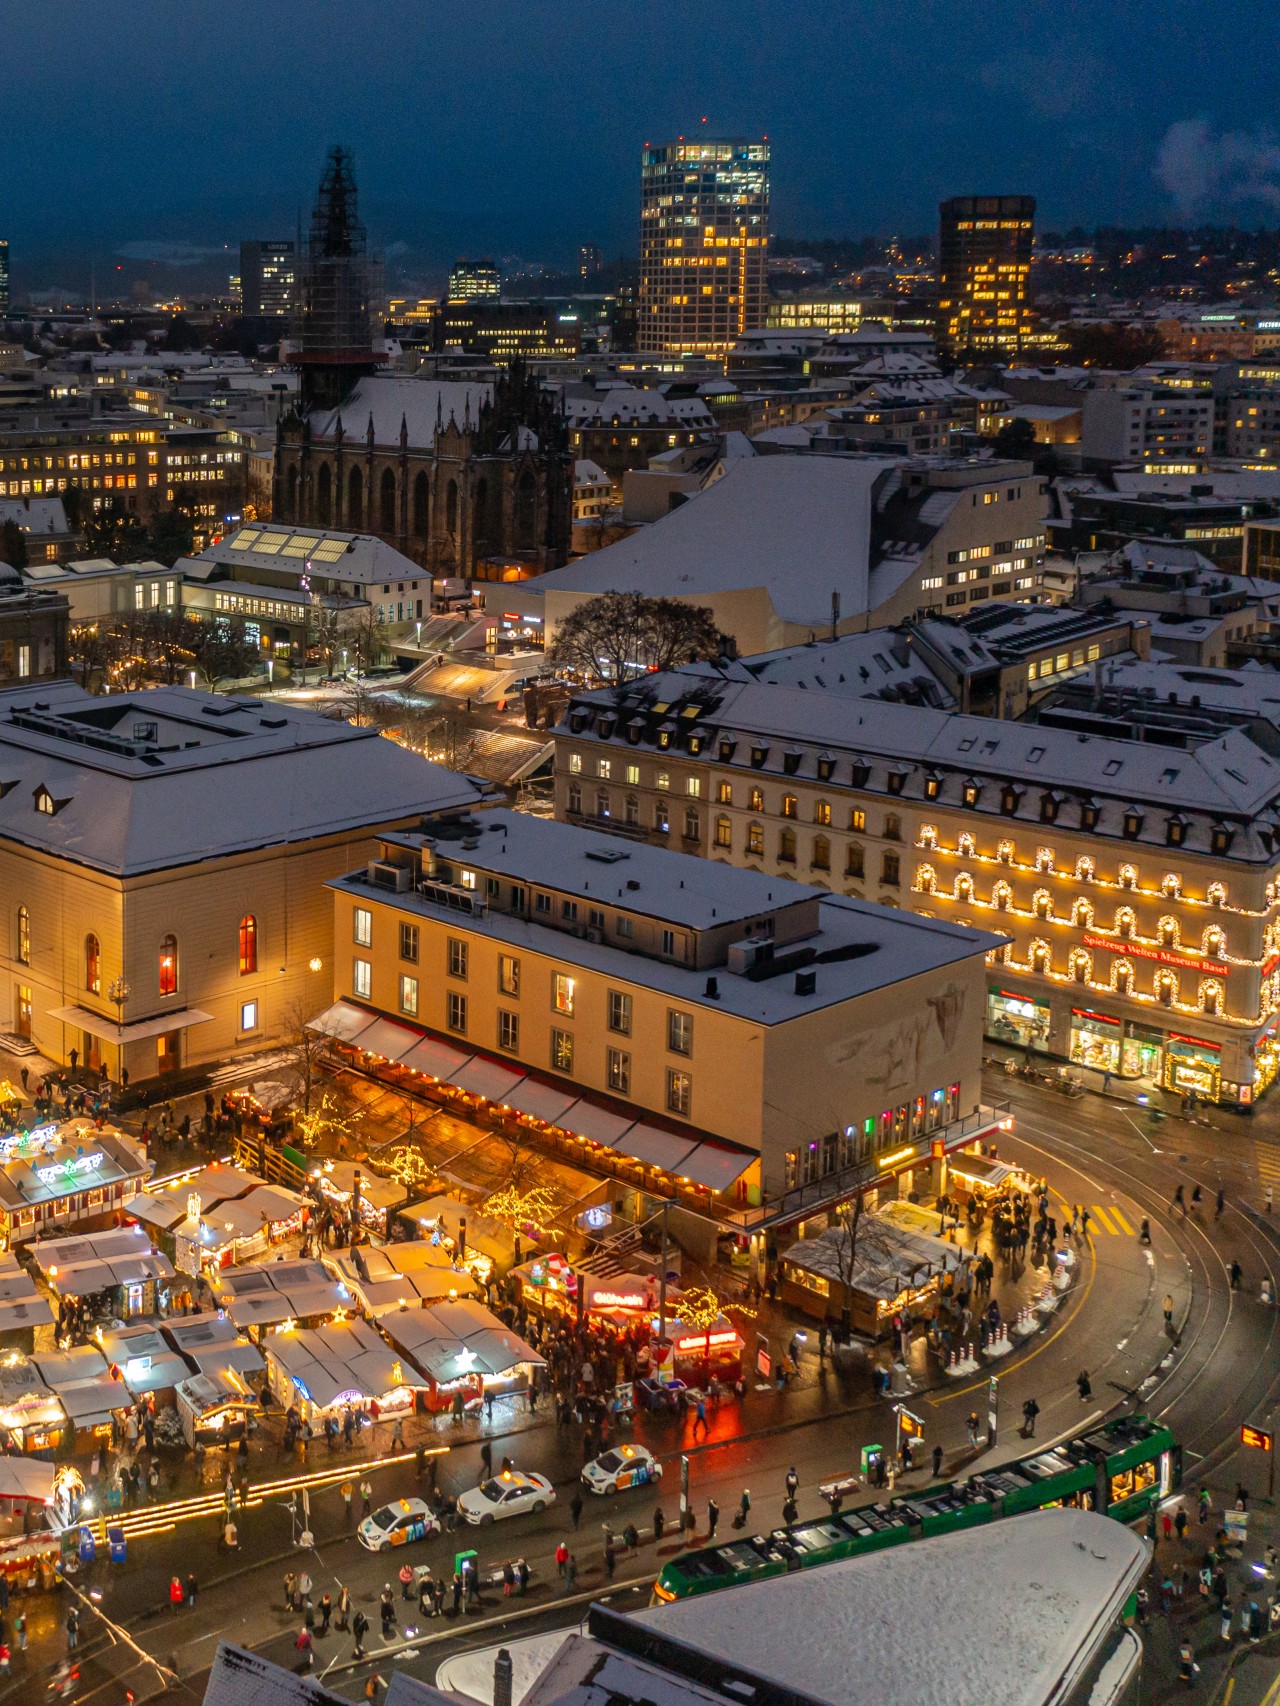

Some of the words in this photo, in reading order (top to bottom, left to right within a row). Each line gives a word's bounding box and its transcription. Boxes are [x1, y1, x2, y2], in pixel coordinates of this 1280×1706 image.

[1083, 934, 1126, 953] Spielzeug
[1127, 943, 1158, 959] Welten
[1160, 951, 1200, 969] Museum
[1202, 960, 1228, 975] Basel
